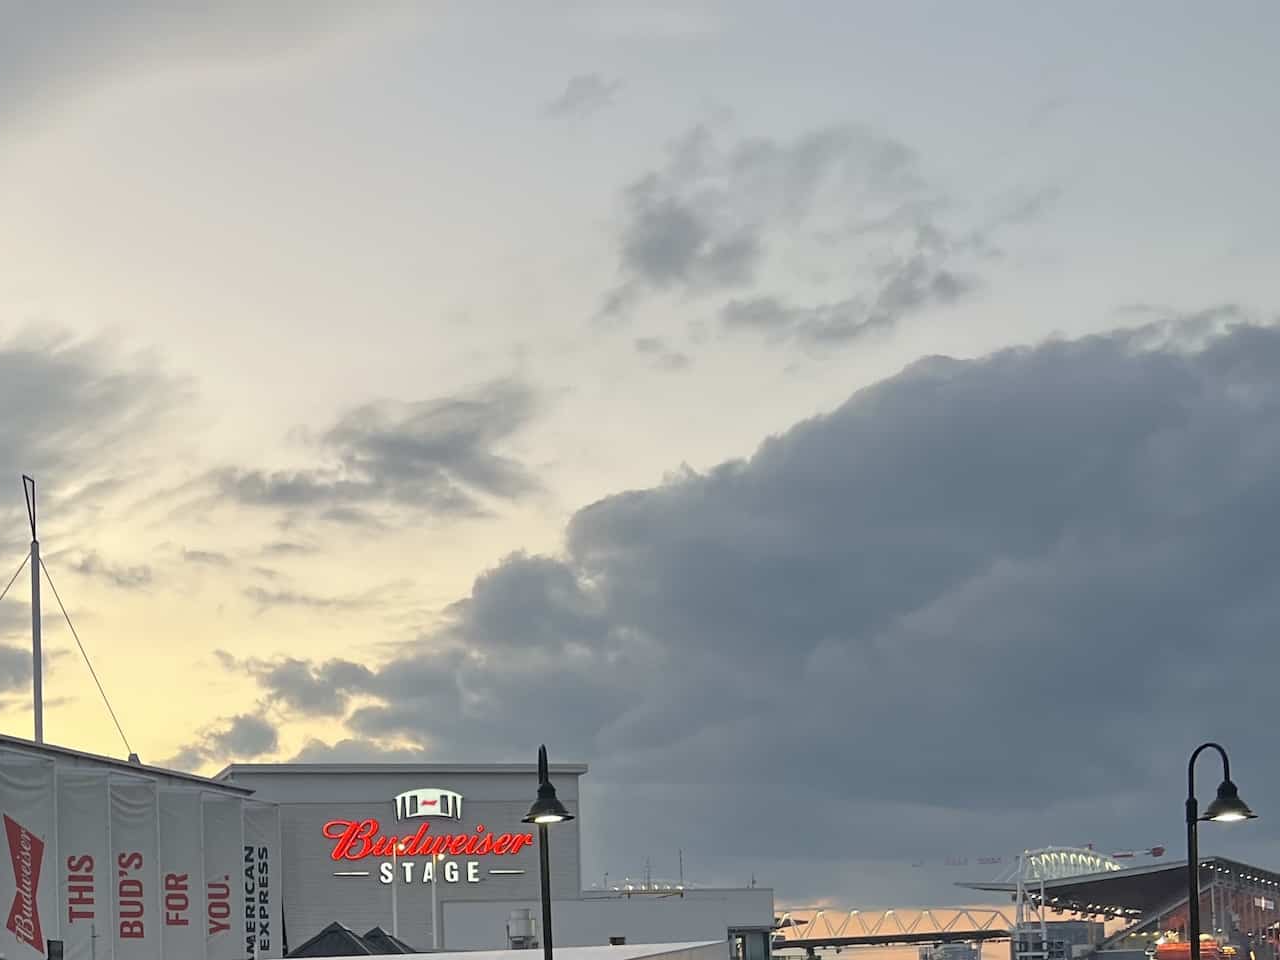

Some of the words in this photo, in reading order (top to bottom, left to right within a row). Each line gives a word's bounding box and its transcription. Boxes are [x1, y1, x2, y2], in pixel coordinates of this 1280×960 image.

[322, 818, 533, 861] Budweiser
[13, 828, 35, 944] Budweiser
[67, 855, 95, 923] THIS
[118, 852, 145, 939] BUD'S
[164, 873, 189, 926] FOR
[257, 846, 270, 951] EXPRESS
[379, 861, 480, 883] STAGE
[207, 875, 231, 936] YOU.
